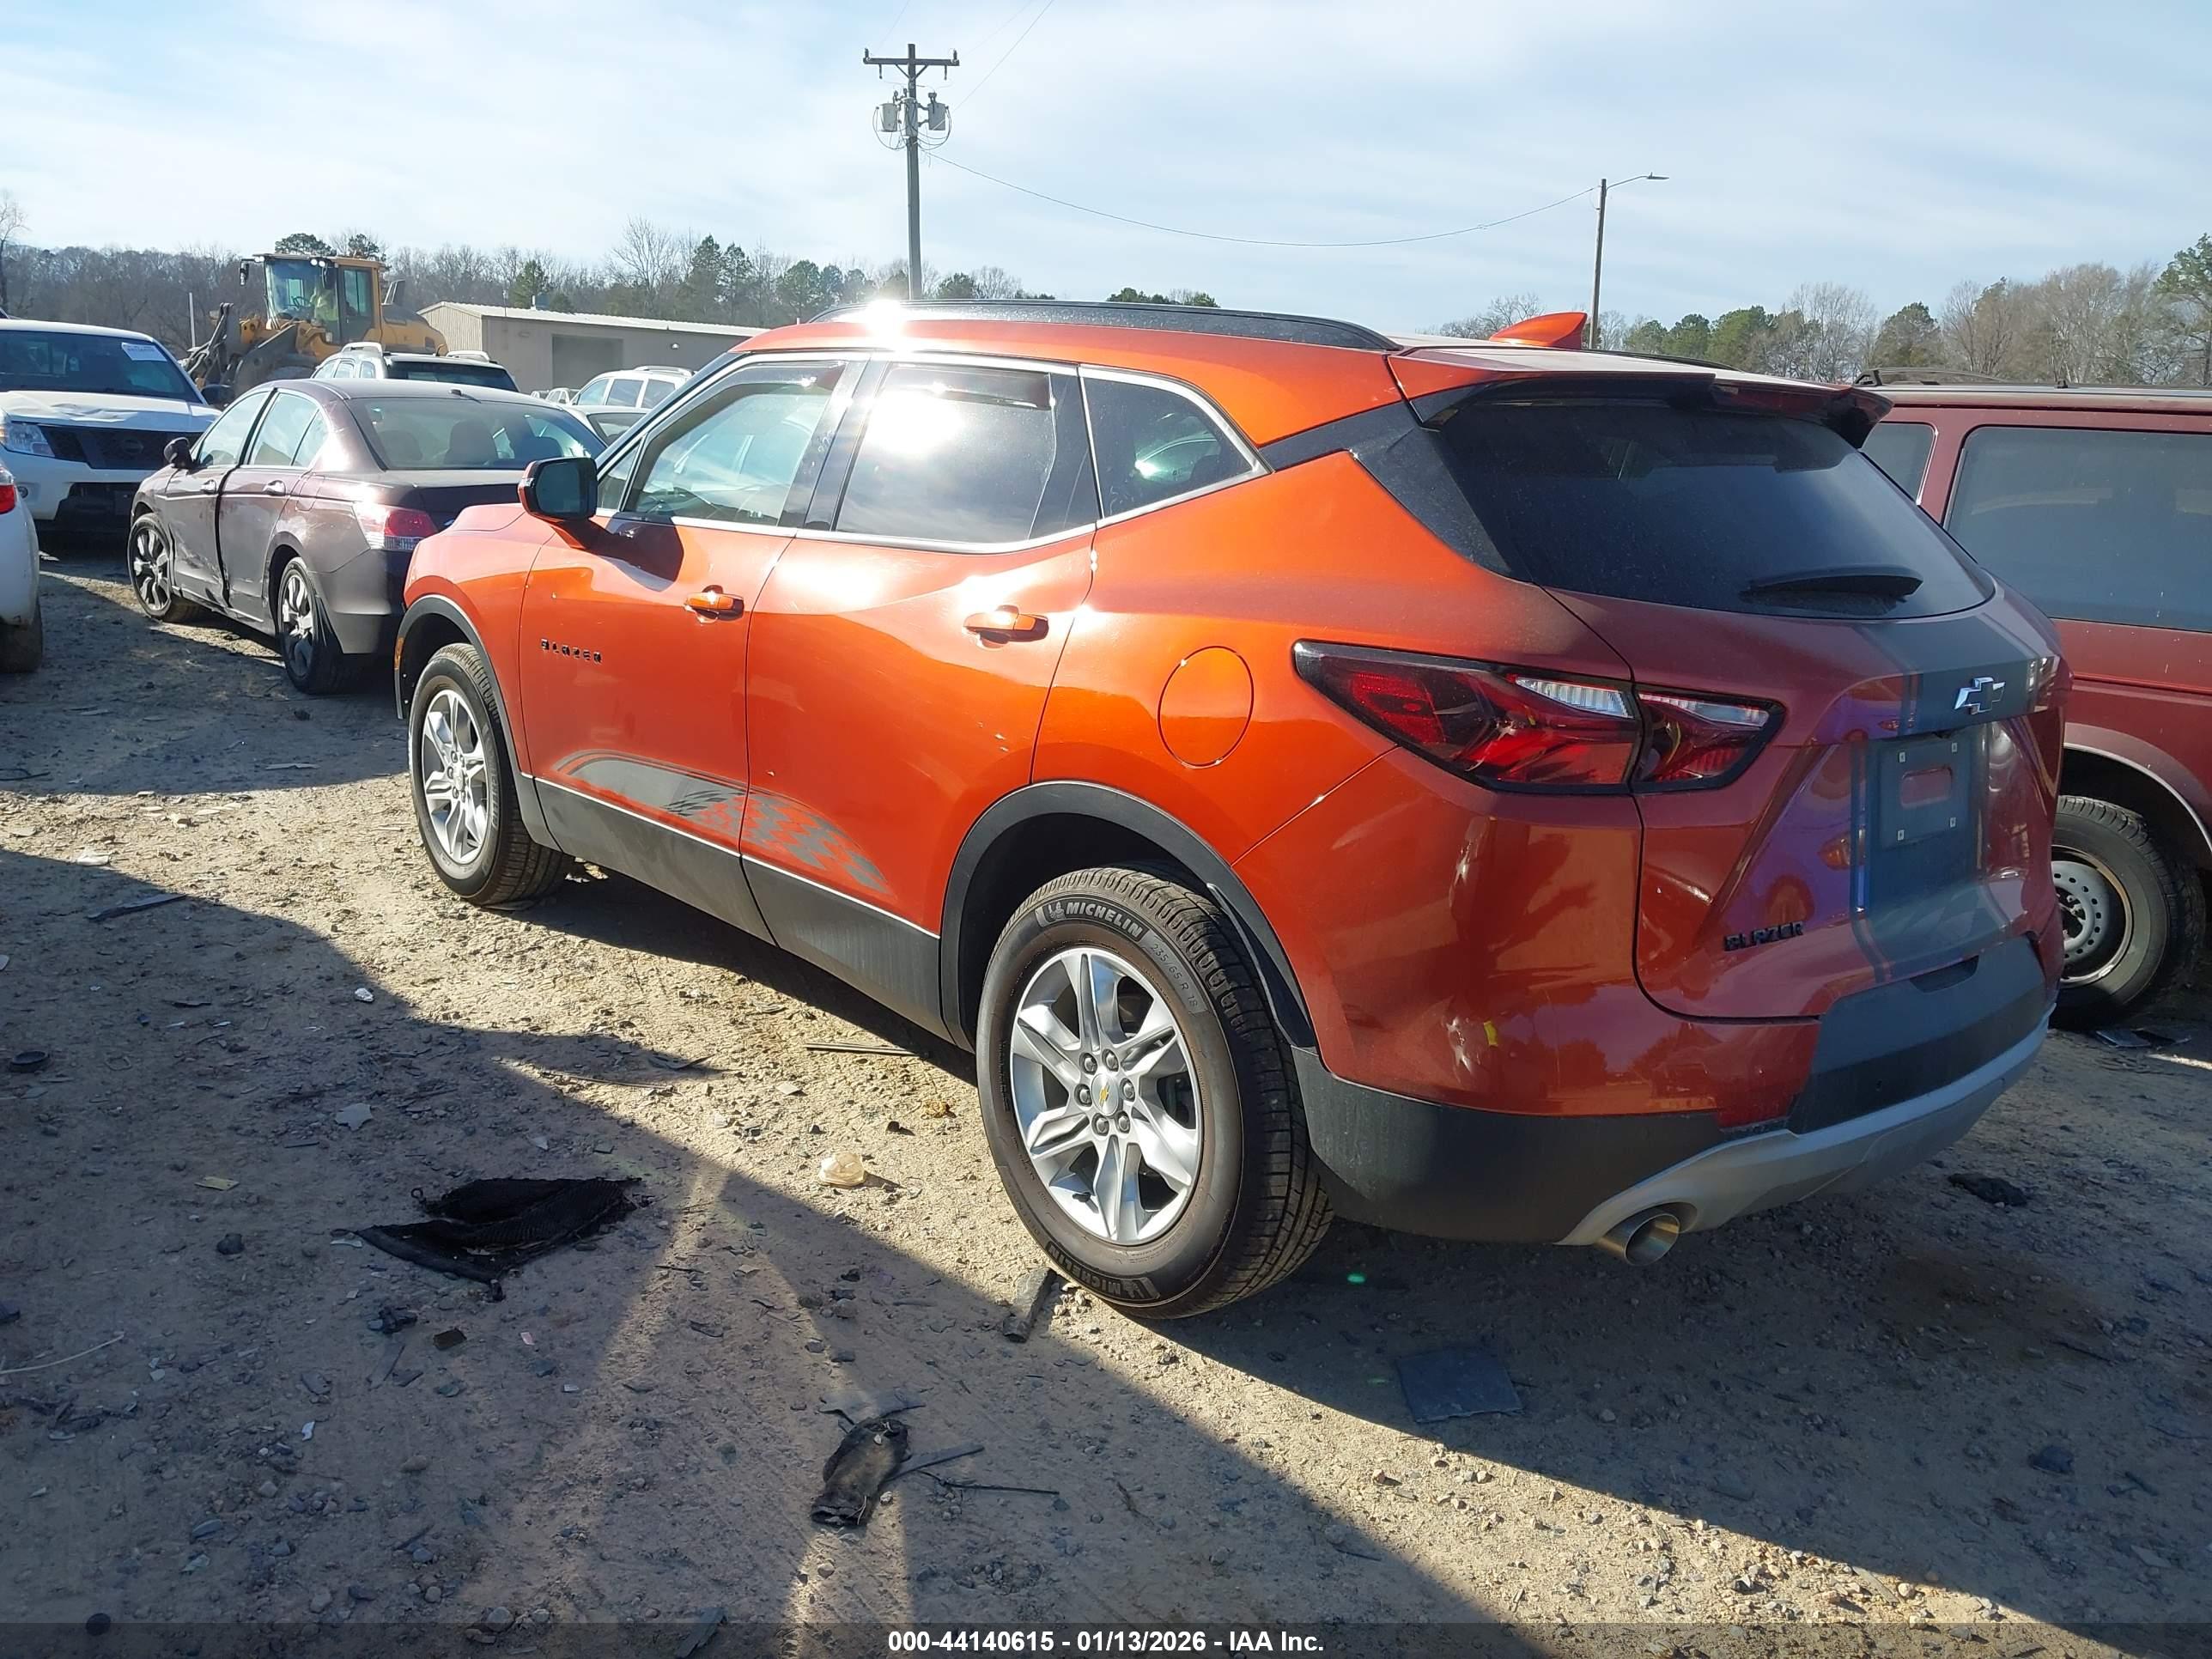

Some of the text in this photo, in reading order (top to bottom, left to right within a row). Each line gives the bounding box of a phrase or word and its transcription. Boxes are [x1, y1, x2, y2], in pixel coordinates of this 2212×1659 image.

[540, 638, 602, 664] BLAZER
[1066, 902, 1143, 939] MICHELIN
[1723, 921, 1804, 951] BLAZER
[1152, 943, 1183, 980] 235/65
[1048, 1247, 1121, 1296] MICHELIN
